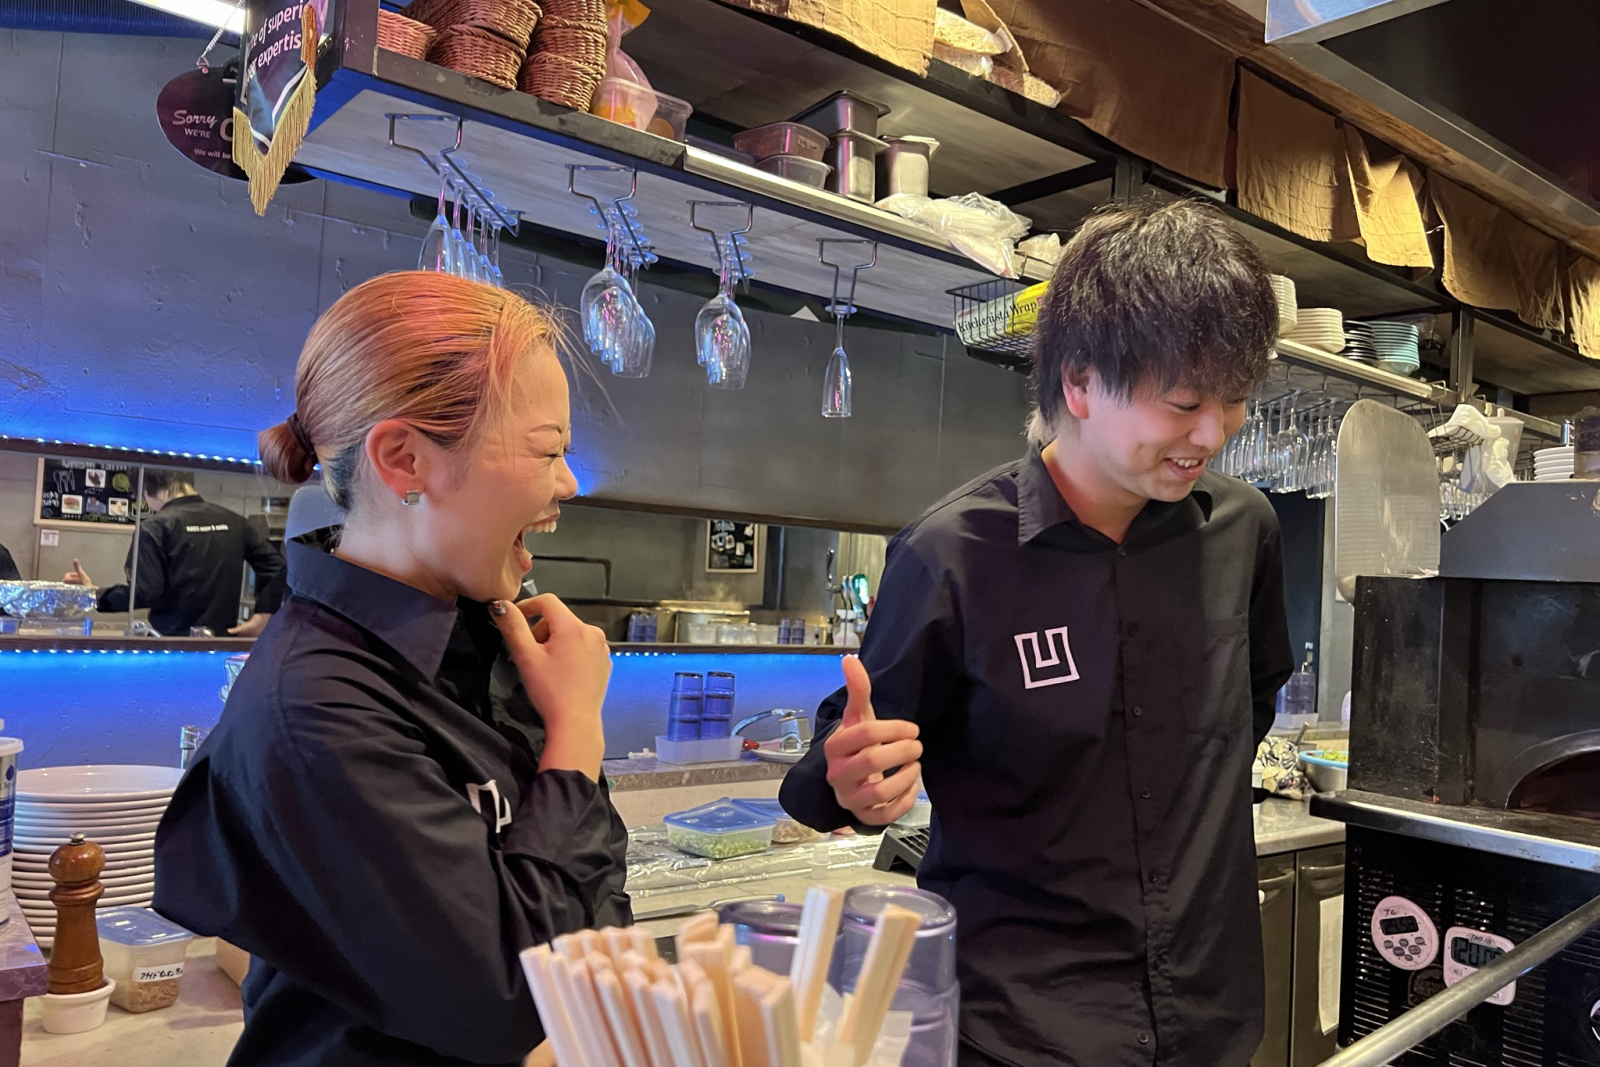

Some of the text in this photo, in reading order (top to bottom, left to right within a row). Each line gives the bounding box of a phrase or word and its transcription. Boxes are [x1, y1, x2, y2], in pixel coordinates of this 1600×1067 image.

[258, 17, 268, 44] of
[267, 0, 303, 34] superi
[257, 30, 302, 68] expertis
[172, 109, 218, 129] Sorry
[184, 128, 211, 139] WE'RE
[207, 150, 221, 158] will
[1009, 301, 1037, 317] Wrap
